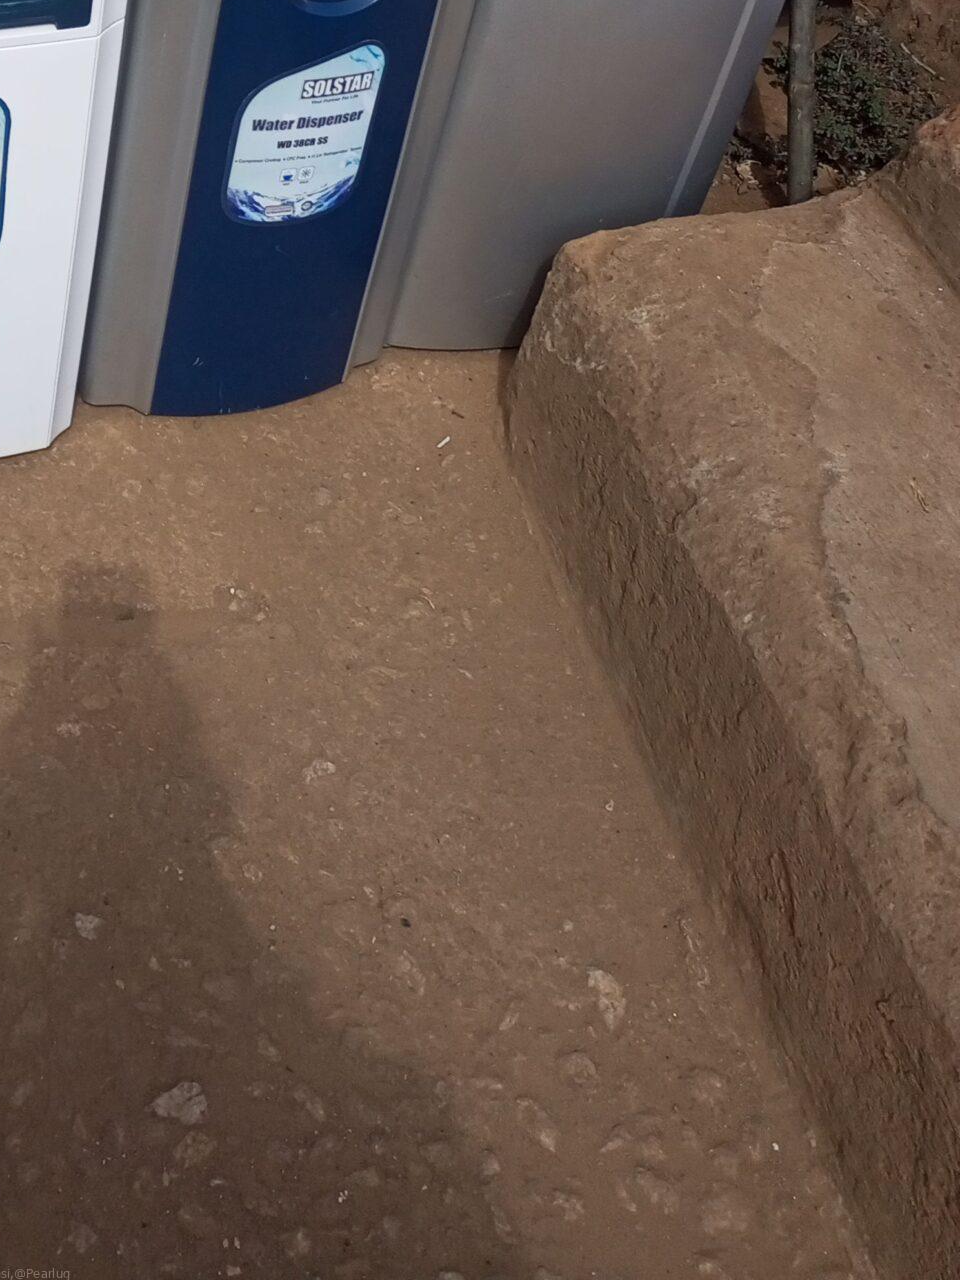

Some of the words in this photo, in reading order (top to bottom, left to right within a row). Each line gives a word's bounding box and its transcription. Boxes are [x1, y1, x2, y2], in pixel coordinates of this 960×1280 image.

[302, 72, 374, 99] SOLSTAR
[251, 119, 294, 132] Water
[296, 109, 364, 129] Dispenser
[277, 140, 292, 149] WD
[317, 136, 329, 145] SS
